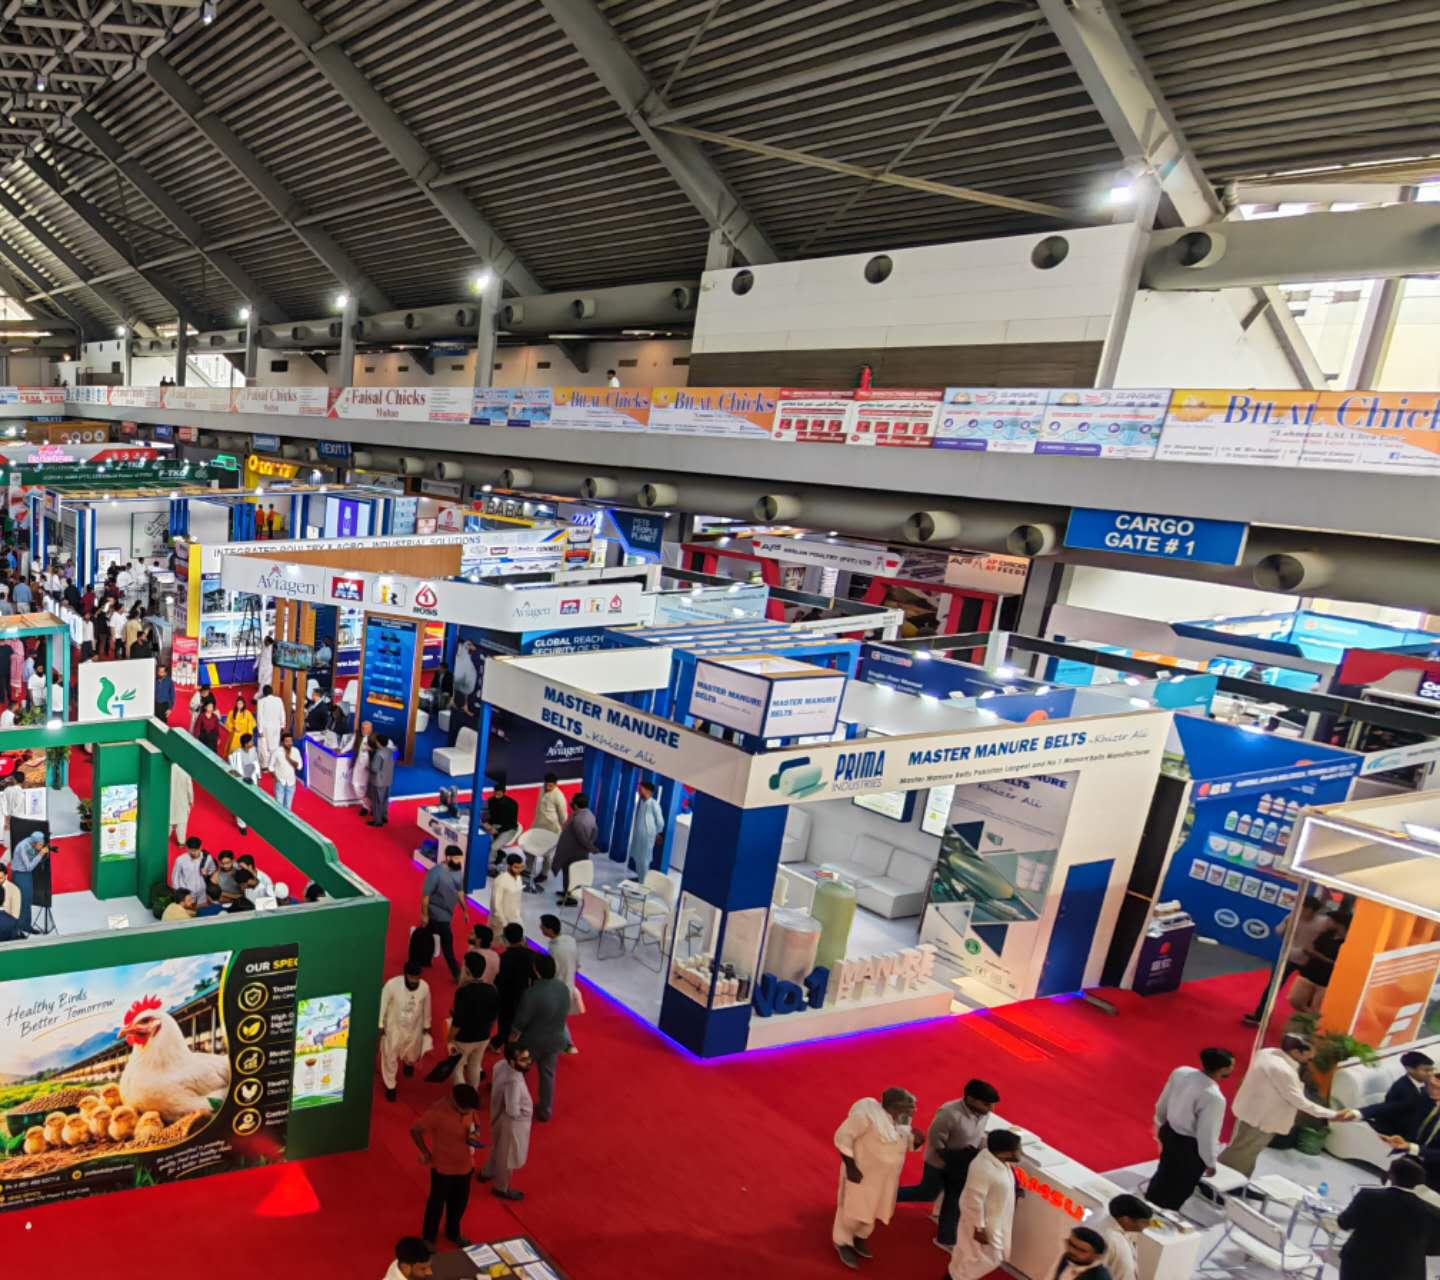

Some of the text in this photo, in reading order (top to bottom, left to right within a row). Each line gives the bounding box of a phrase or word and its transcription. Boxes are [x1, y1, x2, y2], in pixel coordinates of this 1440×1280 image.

[350, 388, 426, 406] Faisal Chicks
[1224, 394, 1323, 425] BILAL
[1114, 514, 1195, 537] CARGO
[213, 545, 279, 558] INTEGRATED
[429, 535, 481, 546] SOLUTIONS
[631, 532, 657, 544] PLANET
[1104, 532, 1195, 556] GATE # 1
[809, 551, 839, 561] POULTRY
[860, 558, 873, 567] LTD
[258, 572, 318, 596] Aviagen
[413, 606, 438, 617] ROSS
[512, 606, 551, 619] Aviagen
[534, 635, 604, 648] GLOBAL REACH
[695, 690, 717, 704] BELTS
[697, 681, 760, 706] MASTER MANURE
[772, 695, 838, 707] MASTER MANURE
[541, 707, 583, 736] BELTS
[544, 686, 680, 749] MASTER MANURE
[770, 709, 792, 718] BELTS
[546, 744, 585, 758] Aviagen
[834, 750, 886, 781] PRIMA
[908, 745, 971, 766] MASTER
[974, 737, 1040, 759] MANURE
[1043, 731, 1089, 751] BELTS
[899, 775, 925, 784] Master
[926, 773, 953, 782] Manure
[955, 770, 972, 779] Belts
[1005, 762, 1031, 773] Largest
[1032, 760, 1045, 768] and
[1106, 748, 1151, 759] Manufacturer
[831, 777, 883, 793] INDUSTRIES
[1030, 774, 1069, 789] NURE
[245, 960, 271, 974] OUR
[839, 947, 935, 984] MANURE
[752, 965, 831, 1018] No.1
[6, 987, 88, 1025] Healthy Birds
[20, 998, 116, 1038] Better Tomorrow
